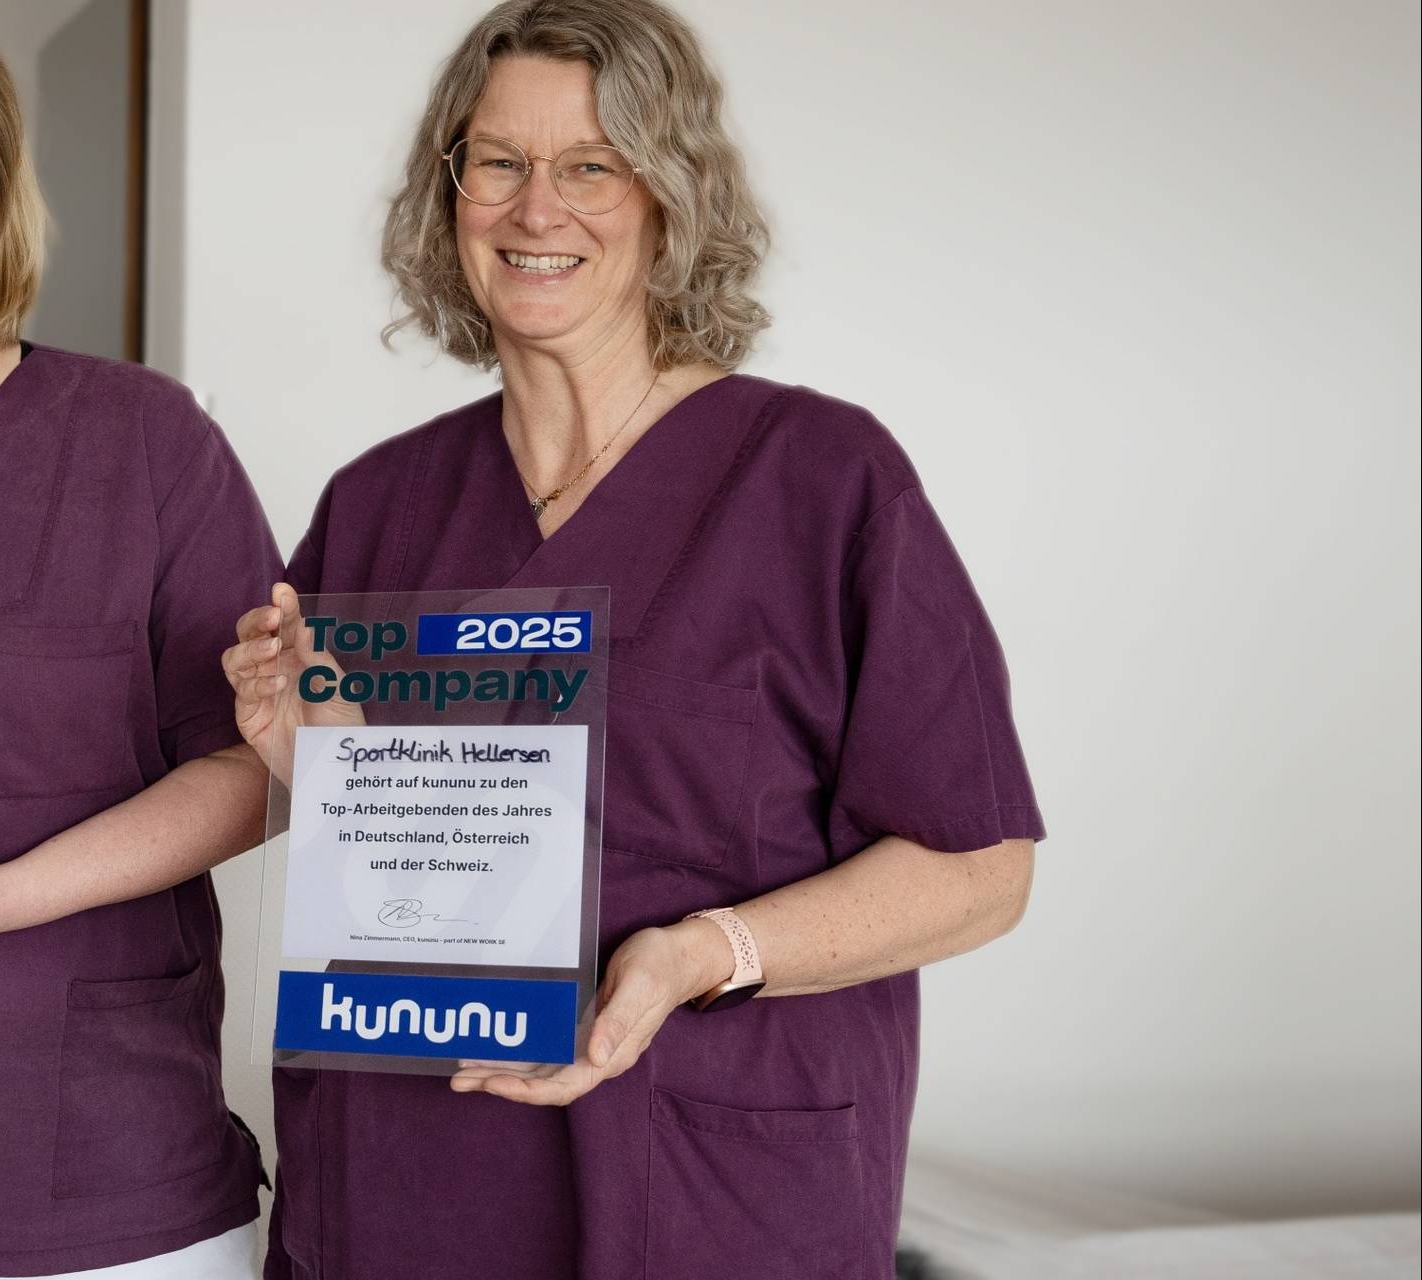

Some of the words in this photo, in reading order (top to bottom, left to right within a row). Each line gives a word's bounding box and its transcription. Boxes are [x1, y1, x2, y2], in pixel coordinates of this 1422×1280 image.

[305, 616, 408, 661] Top
[456, 616, 582, 650] 2025
[298, 665, 589, 713] Company
[336, 736, 454, 772] Sportklinik
[461, 741, 551, 764] Hellersen
[345, 775, 392, 790] gehört
[396, 776, 419, 789] auf
[422, 776, 476, 789] kununu
[480, 779, 497, 789] zu
[500, 776, 528, 789] den
[321, 802, 468, 818] Top-Arbeitgebenden
[472, 804, 498, 816] des
[502, 804, 552, 817] Jahres
[338, 829, 351, 842] in
[355, 830, 448, 846] Deutschland,
[452, 828, 529, 845] Österreich
[370, 858, 397, 870] und
[401, 858, 424, 871] der
[428, 859, 493, 872] Schweiz.
[320, 983, 527, 1047] kununu
